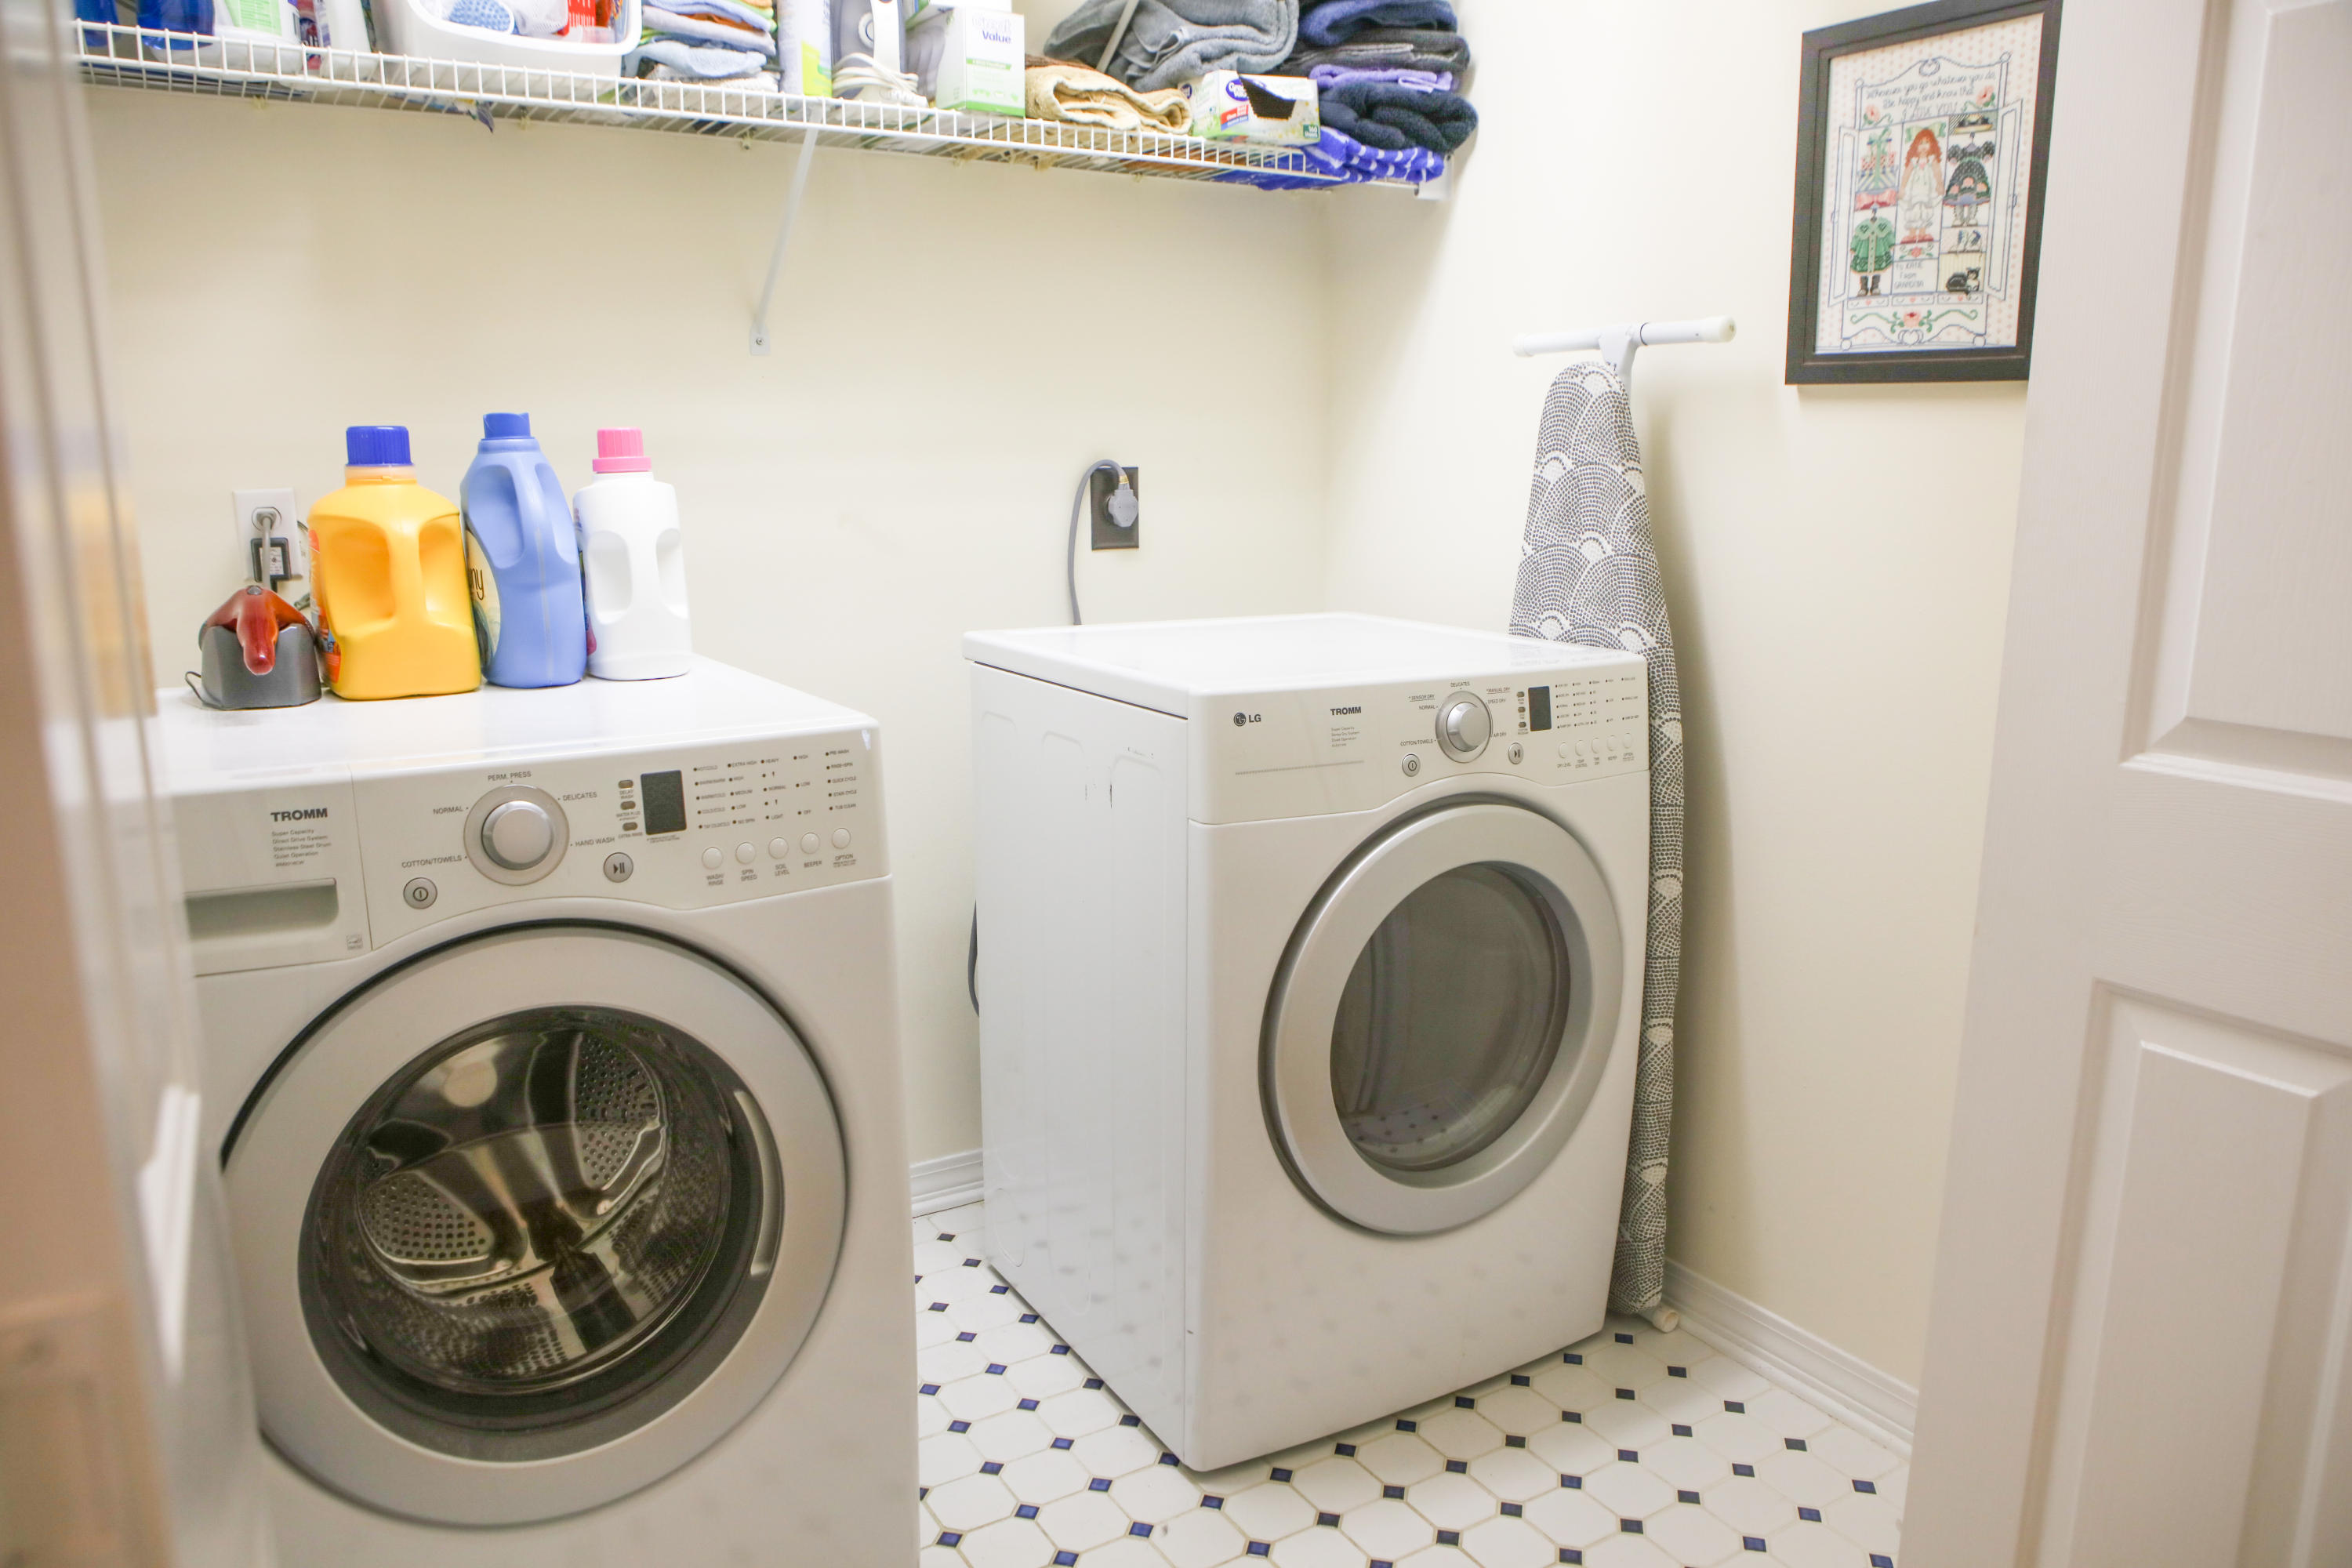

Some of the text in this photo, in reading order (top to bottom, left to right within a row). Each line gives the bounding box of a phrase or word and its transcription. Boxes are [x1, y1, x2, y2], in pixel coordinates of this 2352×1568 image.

[982, 30, 1011, 43] Value
[1330, 706, 1362, 716] TROMM
[1248, 713, 1261, 723] LG
[563, 791, 598, 801] DELICATES
[270, 808, 328, 822] TROMM
[433, 806, 463, 815] NORMAL
[575, 838, 594, 847] HAND
[401, 855, 463, 869] COTTON/TOWELS
